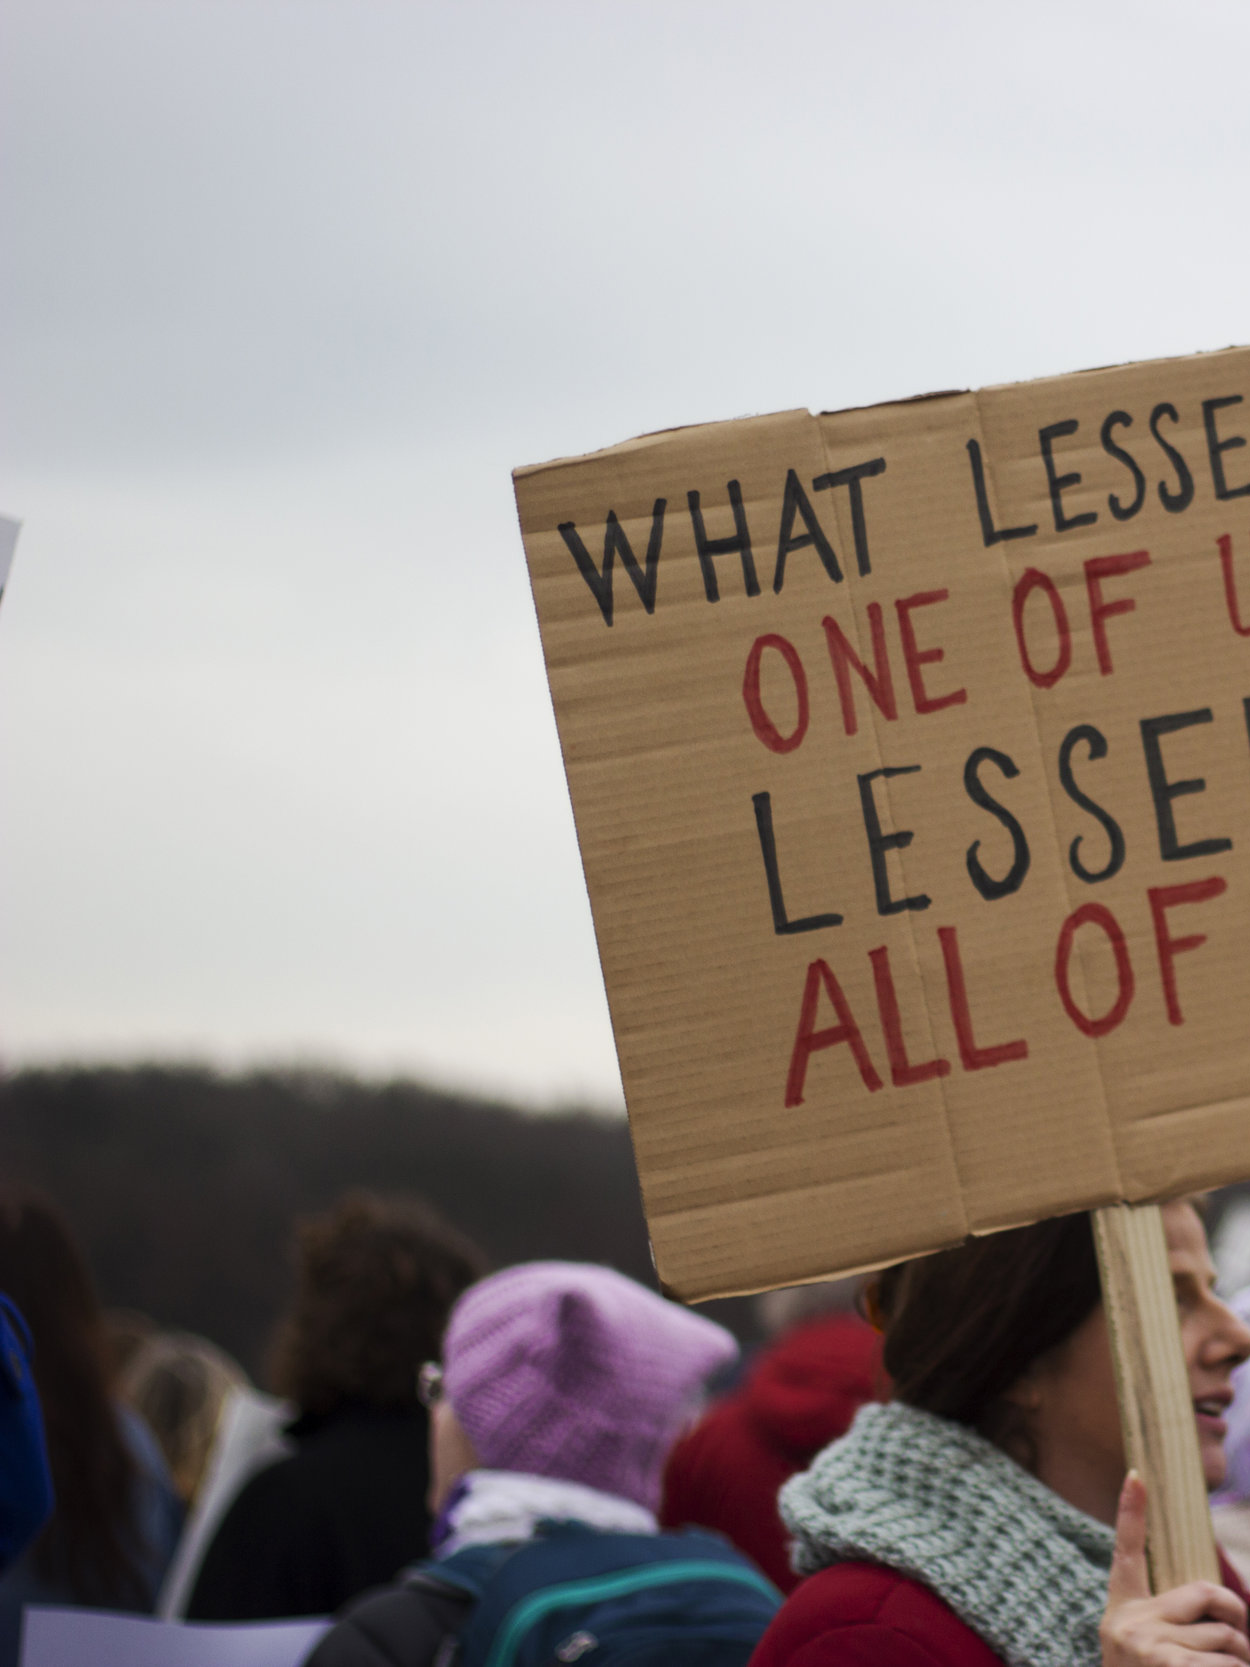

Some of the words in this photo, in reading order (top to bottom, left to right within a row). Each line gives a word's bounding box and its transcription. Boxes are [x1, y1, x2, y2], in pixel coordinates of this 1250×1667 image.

[556, 458, 887, 627] WHAT
[741, 589, 967, 755] ONE
[1012, 550, 1152, 689] OF
[784, 926, 1030, 1108] ALL
[1055, 876, 1228, 1038] OF
